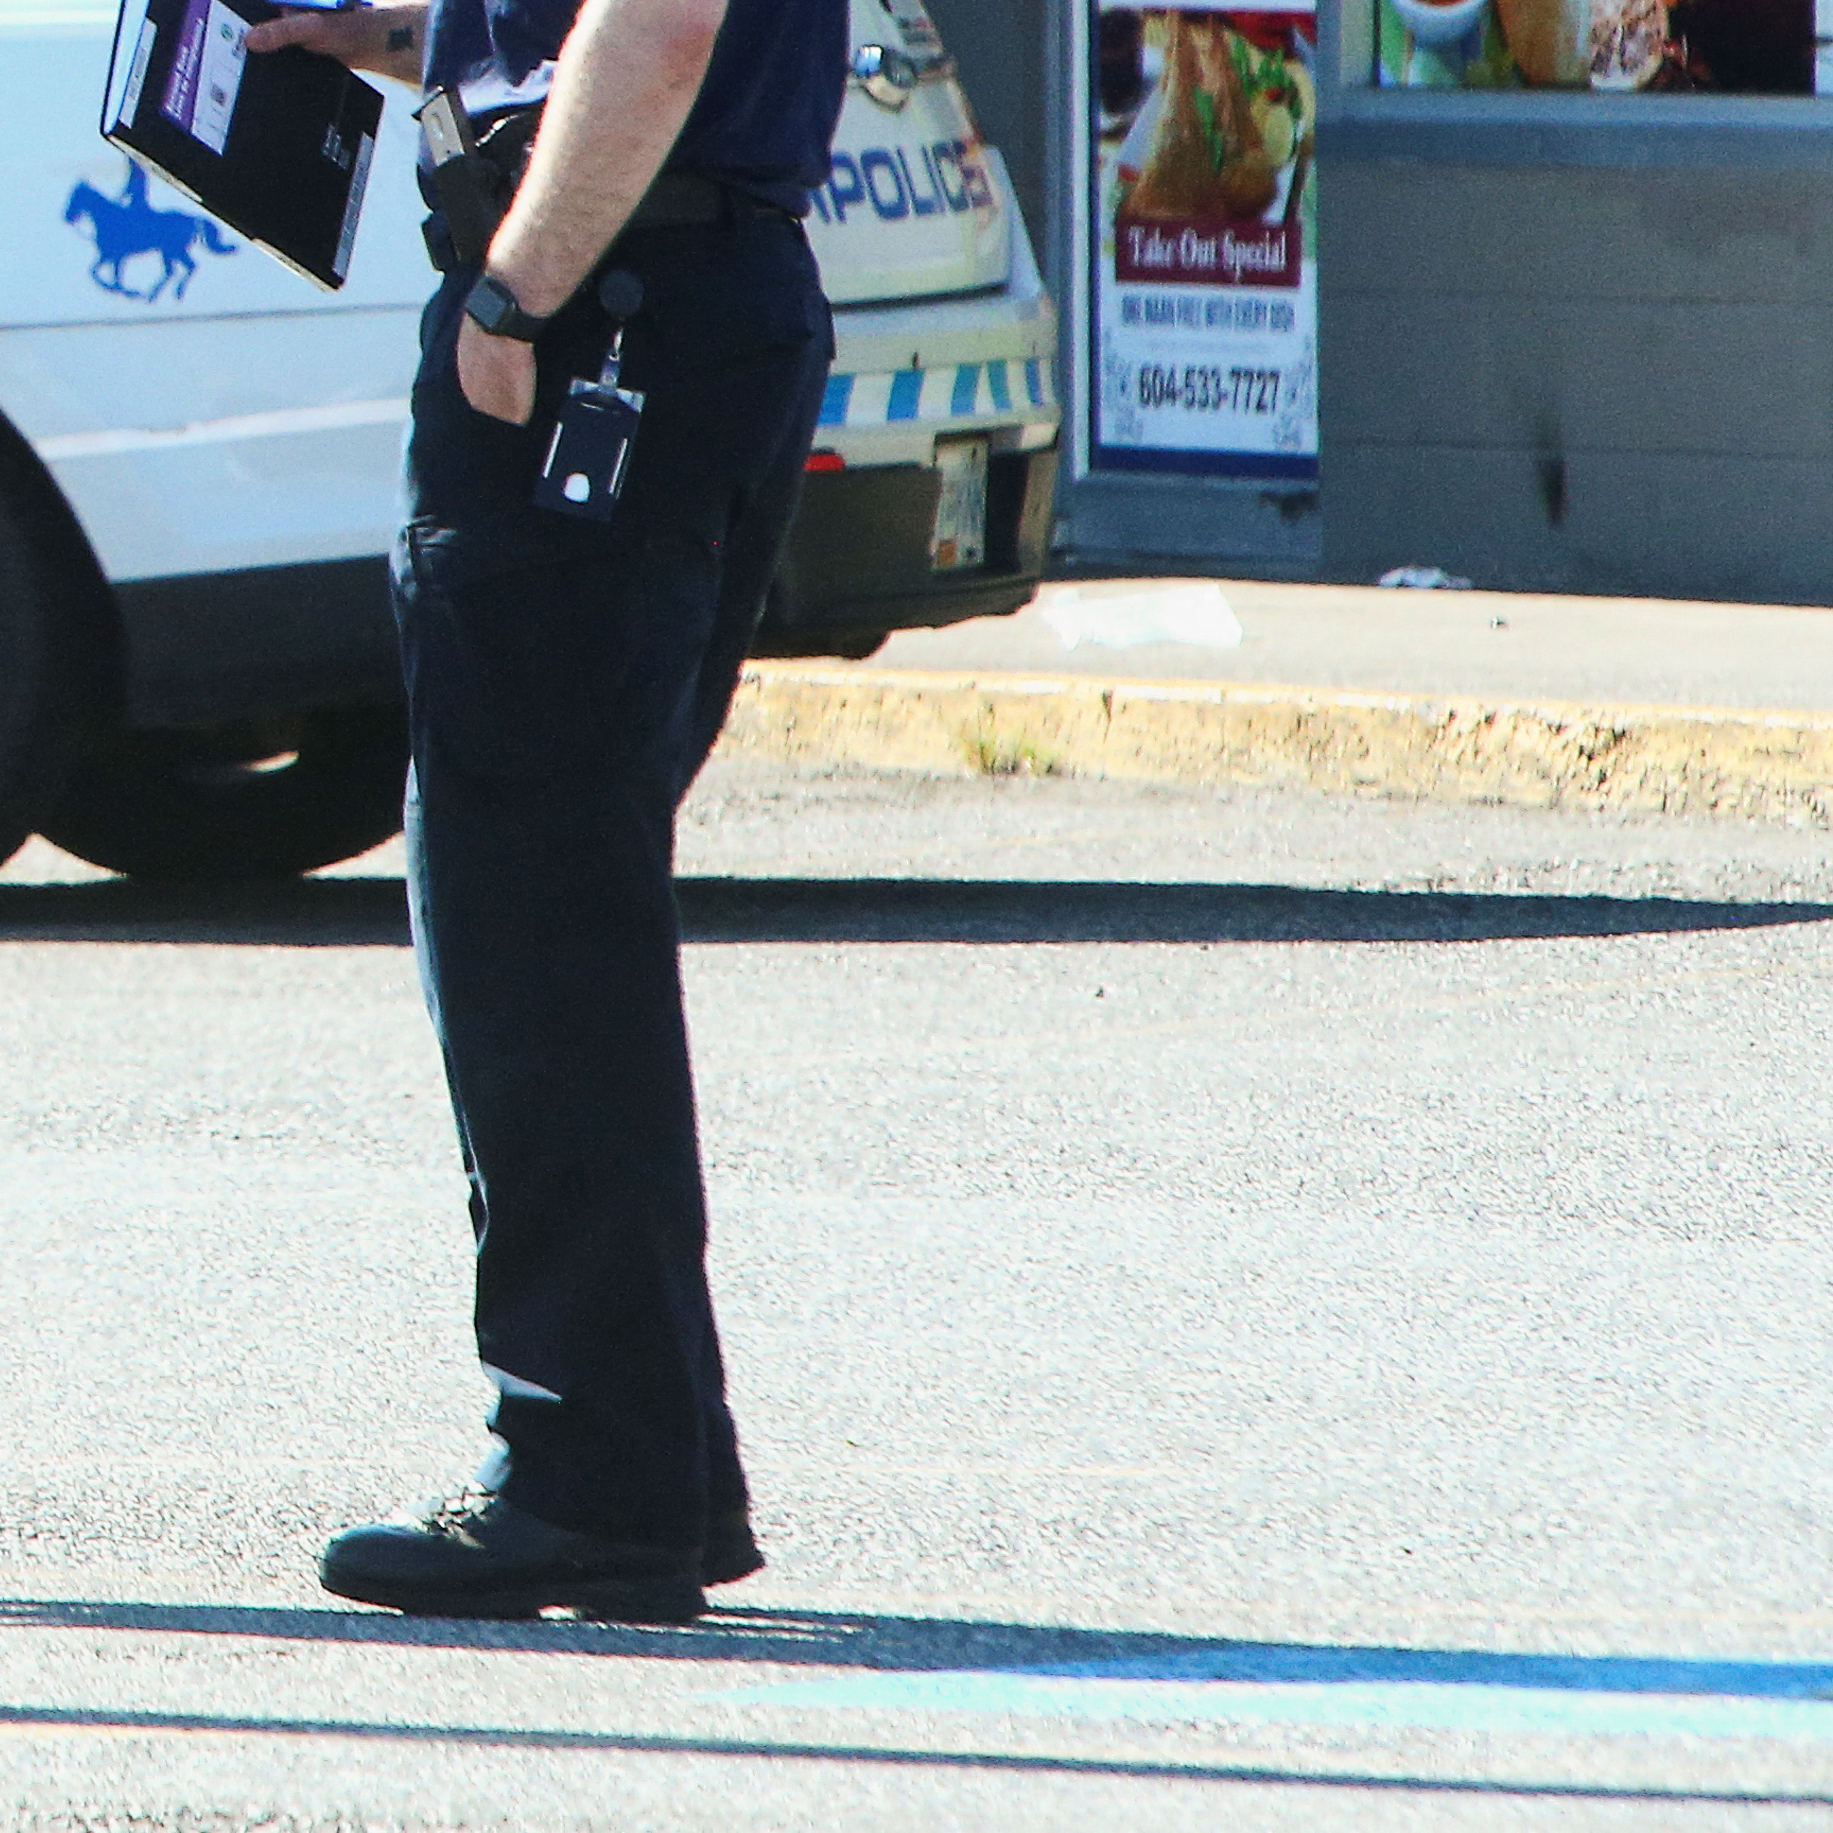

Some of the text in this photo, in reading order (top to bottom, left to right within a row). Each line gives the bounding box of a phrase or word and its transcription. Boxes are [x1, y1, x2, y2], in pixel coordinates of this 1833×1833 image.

[1129, 226, 1286, 284] Take Out Special
[1139, 364, 1281, 414] 604-533-7727
